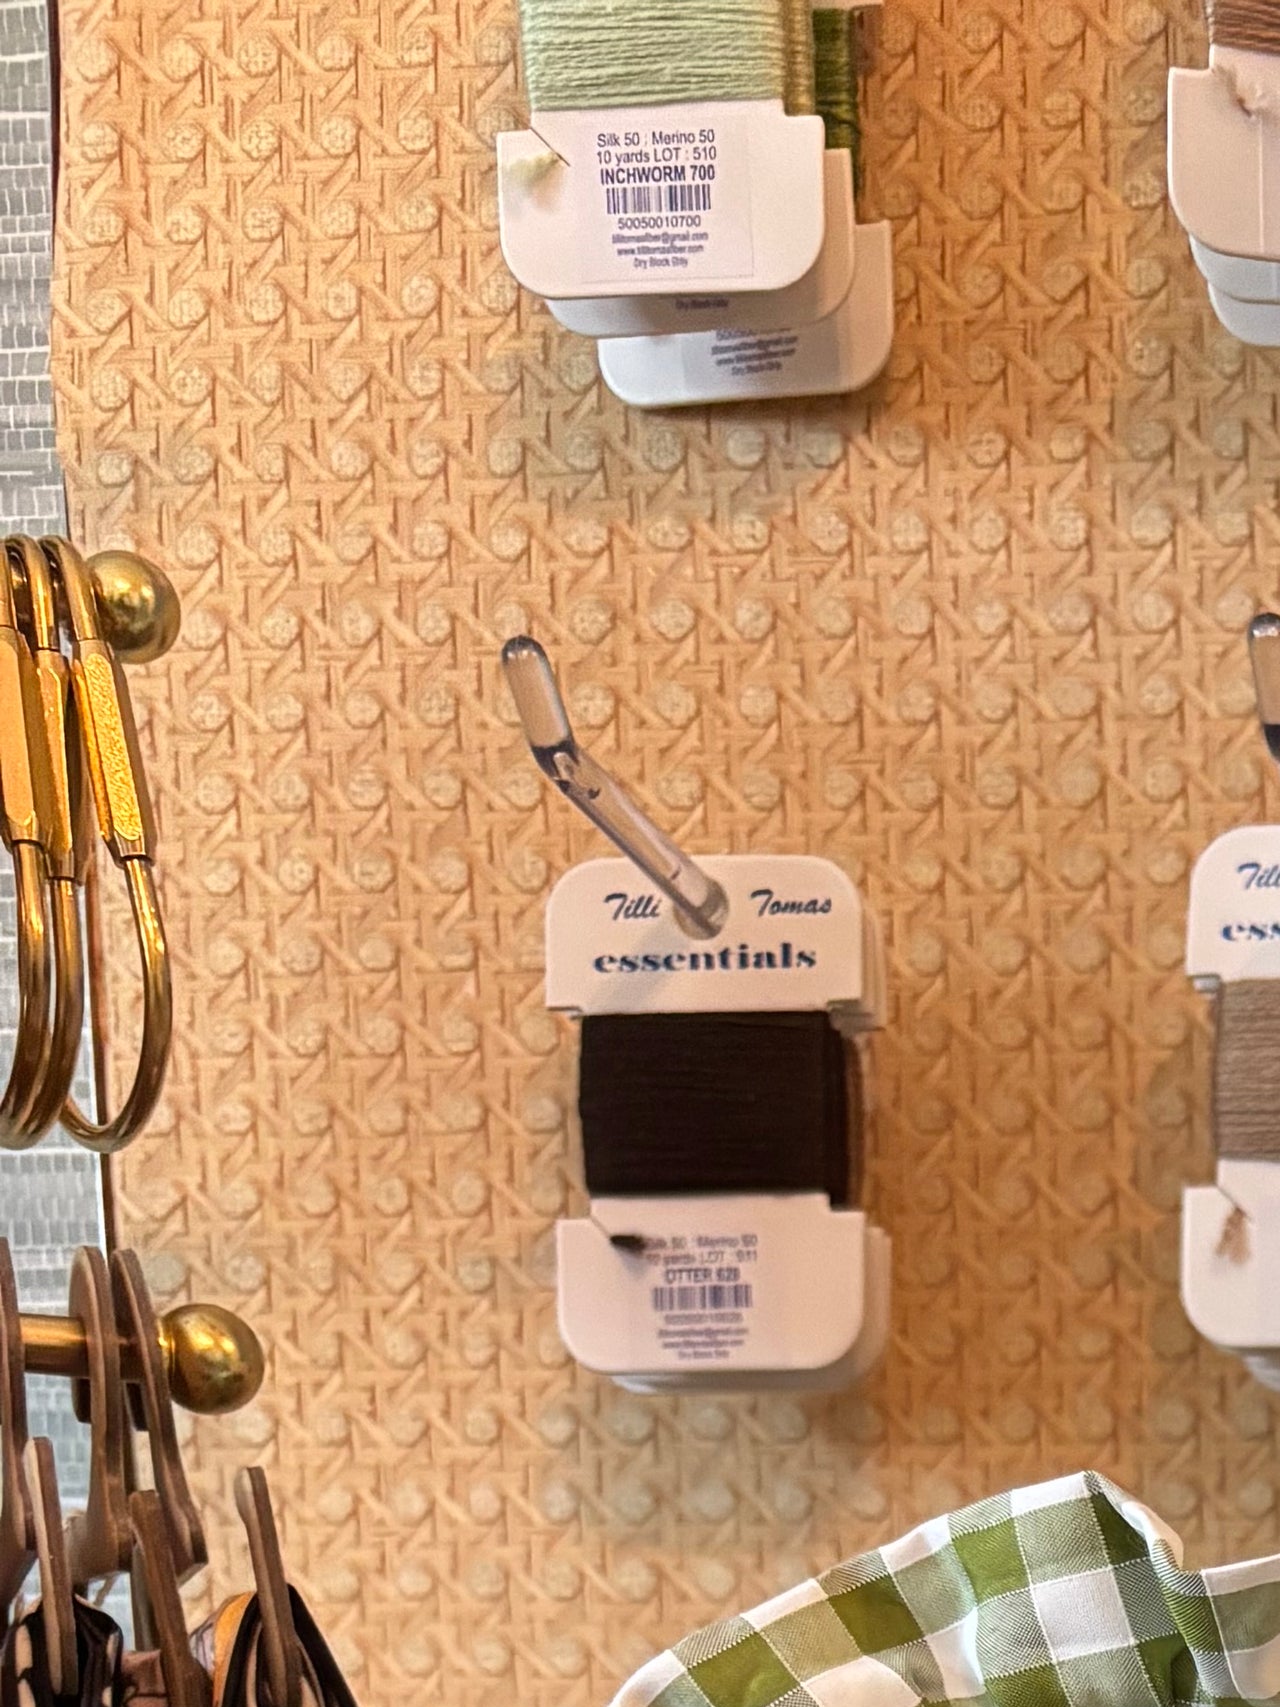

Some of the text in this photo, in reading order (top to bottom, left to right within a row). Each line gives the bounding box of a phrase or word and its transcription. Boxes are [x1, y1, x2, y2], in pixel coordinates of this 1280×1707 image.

[597, 133, 621, 148] Silk
[624, 132, 640, 146] 50
[652, 131, 695, 145] Merino
[699, 129, 715, 144] 50
[597, 150, 611, 164] 10
[615, 149, 650, 166] yards
[654, 148, 681, 162] LOT
[693, 146, 717, 160] 510
[600, 164, 715, 185] INCHWORM 700
[618, 215, 701, 230] 50050010700
[604, 889, 832, 921] Tilli Tomas
[594, 943, 816, 973] essentials
[665, 1268, 712, 1284] OTTER
